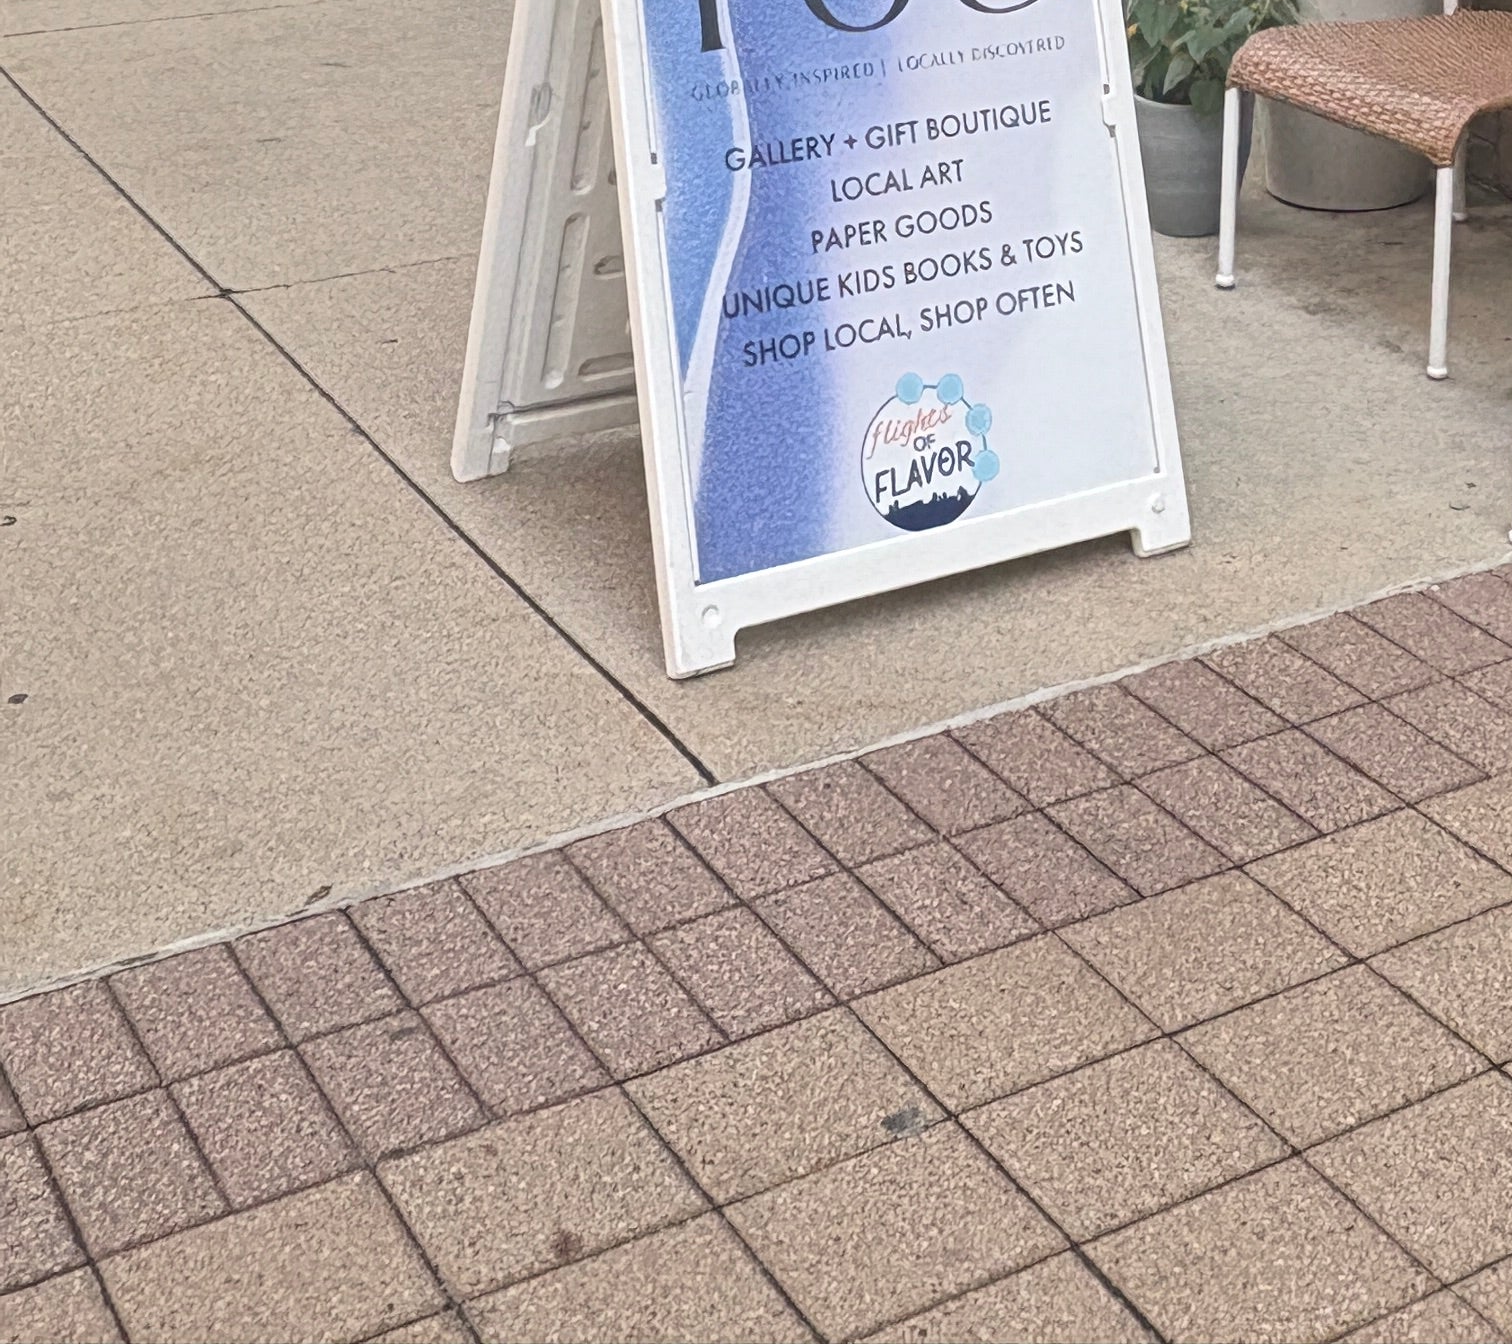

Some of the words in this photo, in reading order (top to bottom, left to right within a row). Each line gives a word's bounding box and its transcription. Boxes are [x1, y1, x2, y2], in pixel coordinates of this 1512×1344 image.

[724, 133, 836, 172] GALLERY
[864, 119, 918, 150] GIFT
[926, 100, 1053, 141] BOUTIQUE
[830, 168, 914, 202] LOCAL
[920, 159, 966, 186] ART
[811, 221, 888, 254] PAPER
[894, 200, 994, 238] GOODS
[722, 277, 831, 319] UNIQUE
[838, 266, 897, 299] KIDS
[903, 247, 993, 285] BOOKS
[1001, 244, 1018, 267] &
[1022, 231, 1084, 265] TOYS
[742, 330, 817, 368] SHOP
[824, 318, 914, 352] LOCAL,
[919, 297, 989, 333] SHOP
[994, 279, 1076, 317] OFTEN
[875, 440, 976, 504] FLAVOR
[913, 433, 936, 452] OF
